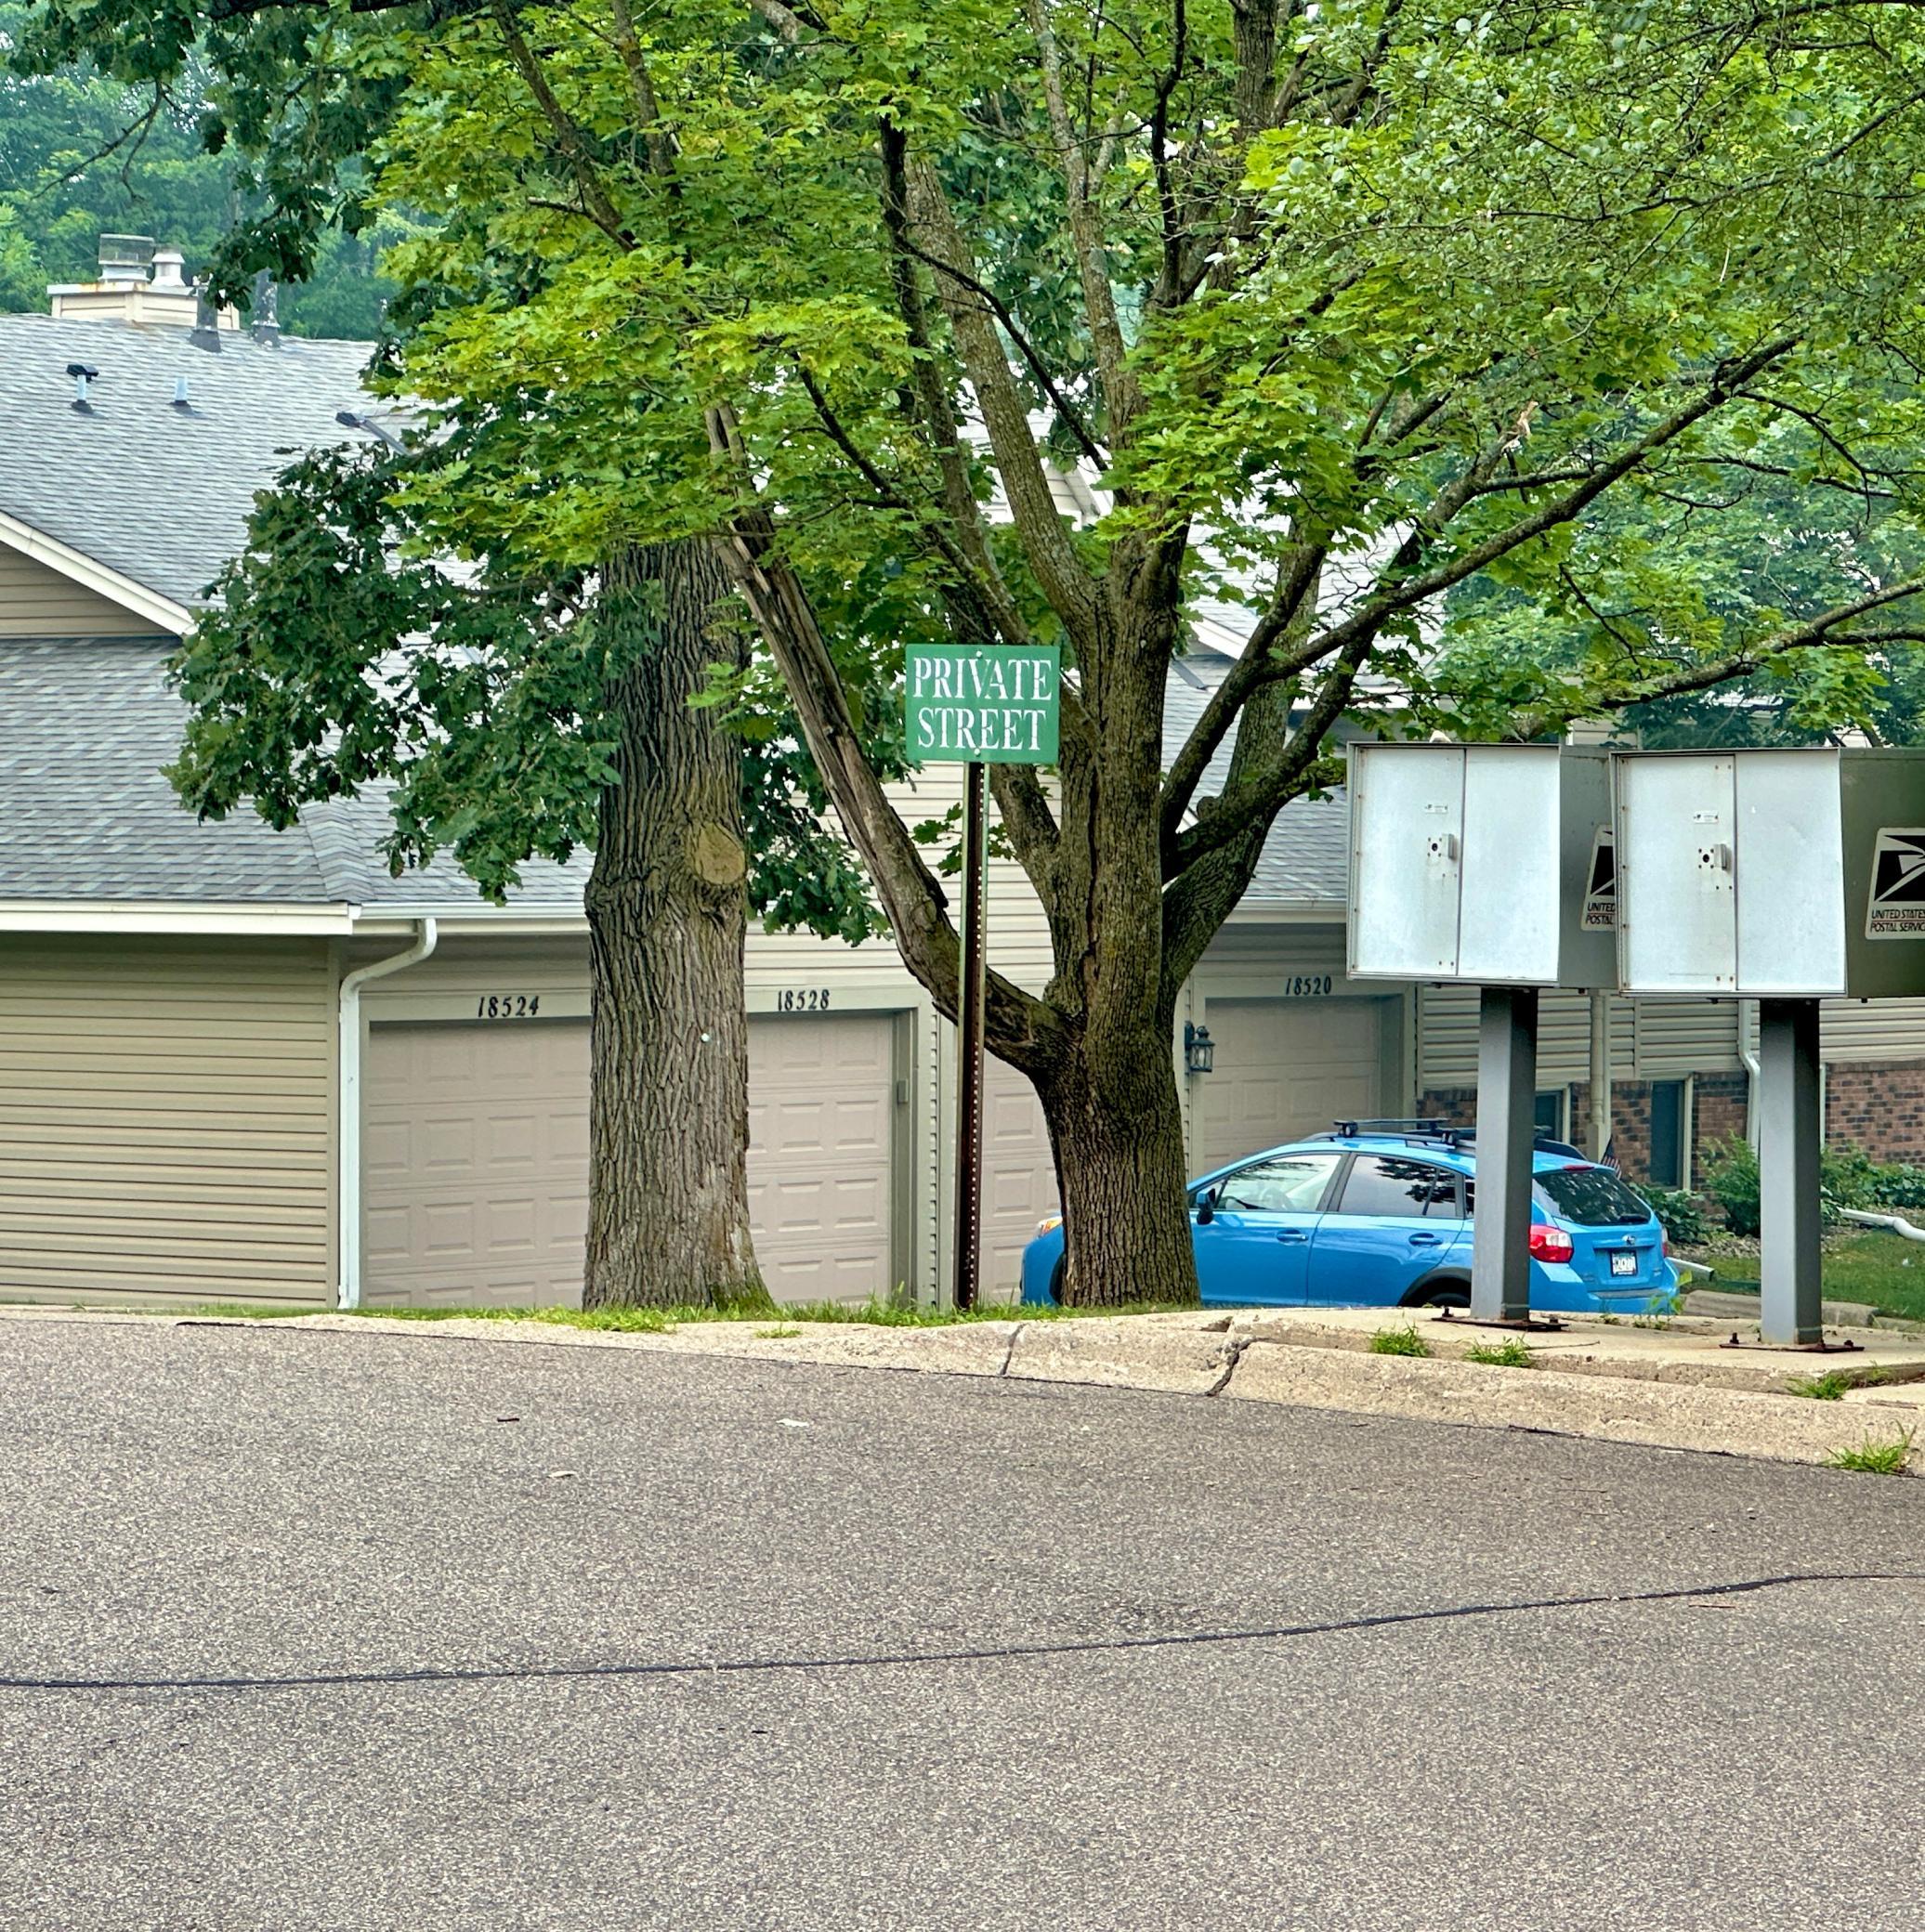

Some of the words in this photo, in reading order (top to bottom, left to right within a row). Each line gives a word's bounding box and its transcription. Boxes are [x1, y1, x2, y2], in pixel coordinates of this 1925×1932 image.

[912, 657, 1053, 701] PRIVATE
[917, 707, 1047, 751] STREET
[1586, 915, 1614, 925] POSTAL
[1872, 908, 1901, 919] UNITED
[1870, 921, 1898, 933] POSTAL
[1286, 975, 1331, 996] 18520
[478, 995, 539, 1018] 18524
[778, 988, 830, 1012] 18528
